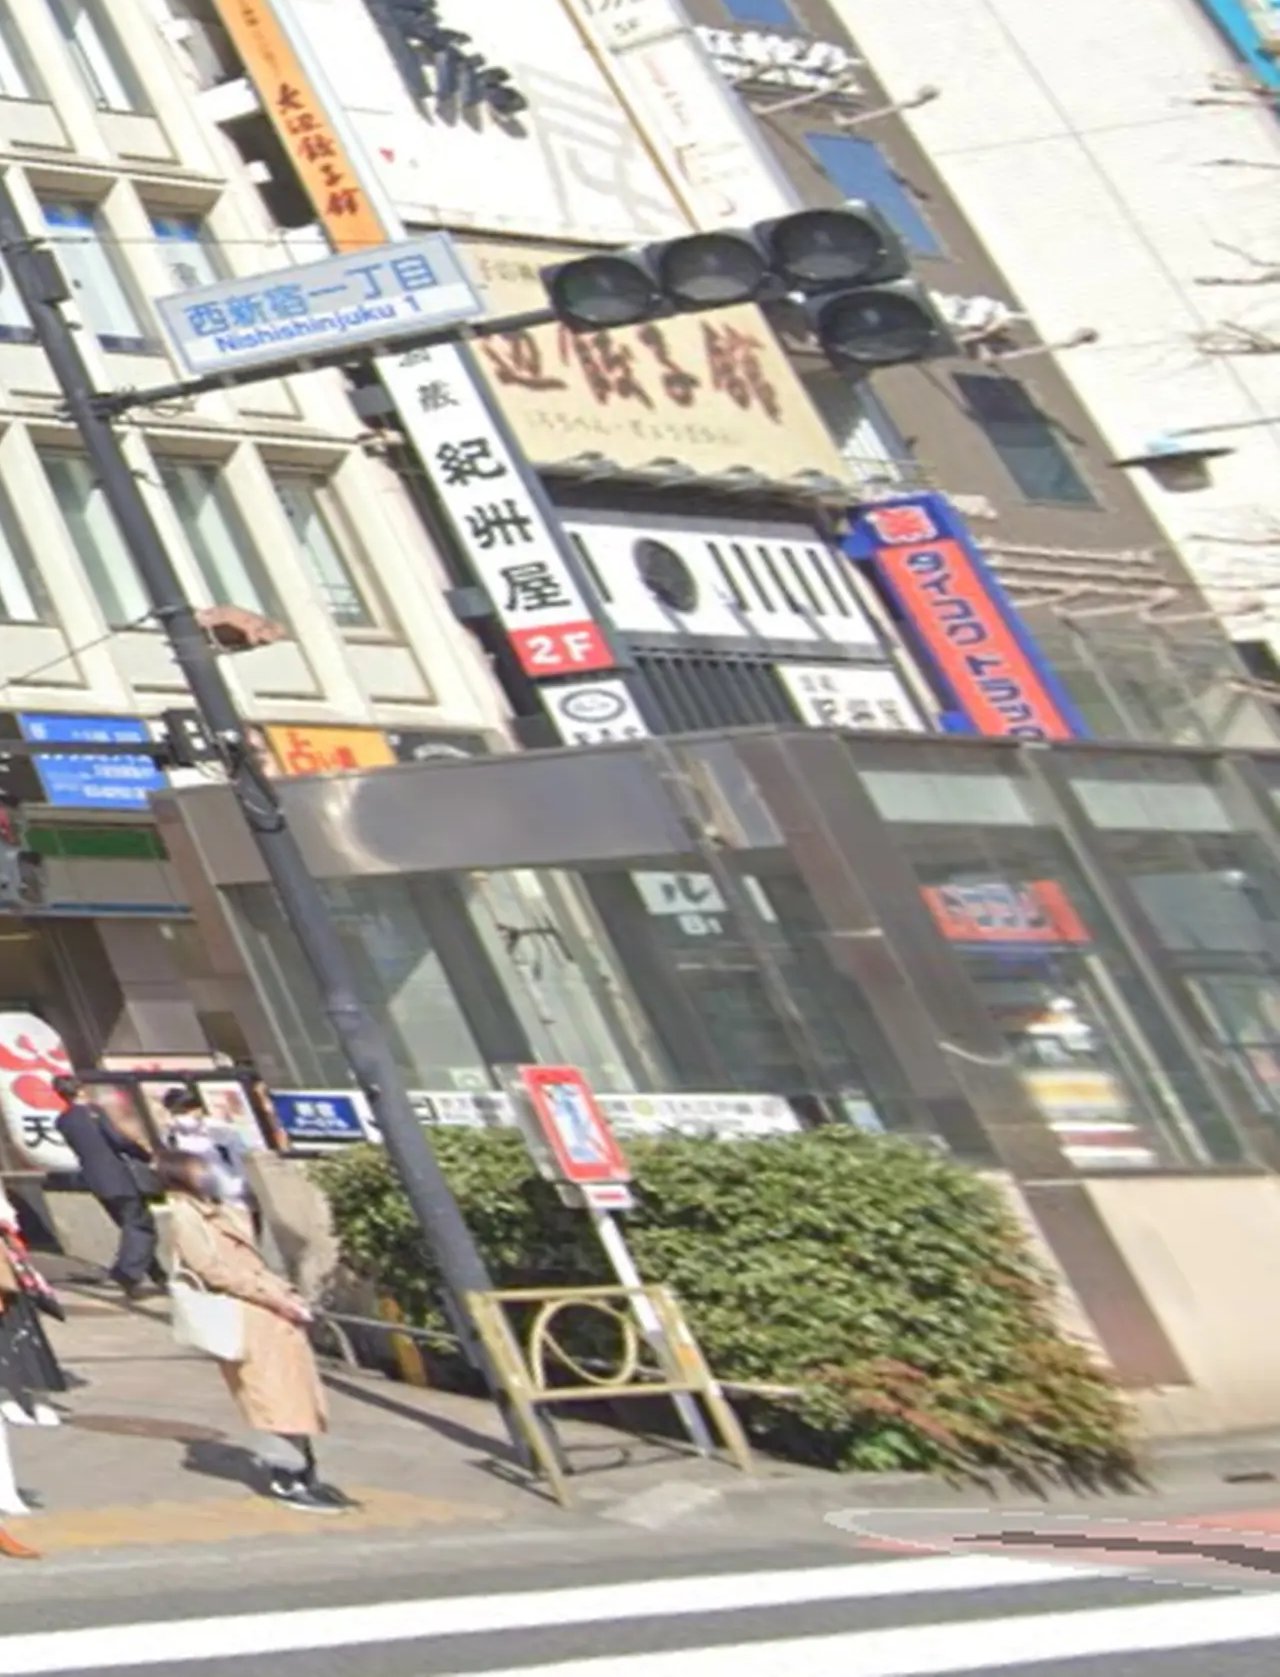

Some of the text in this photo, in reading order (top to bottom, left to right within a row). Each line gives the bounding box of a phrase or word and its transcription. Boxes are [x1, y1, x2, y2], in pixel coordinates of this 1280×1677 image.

[186, 251, 438, 336] 西新宿一丁目
[215, 294, 422, 354] Nishishinjuku 1
[435, 436, 571, 613] 紀州屋
[525, 630, 595, 667] 2F
[21, 1114, 64, 1149] 天
